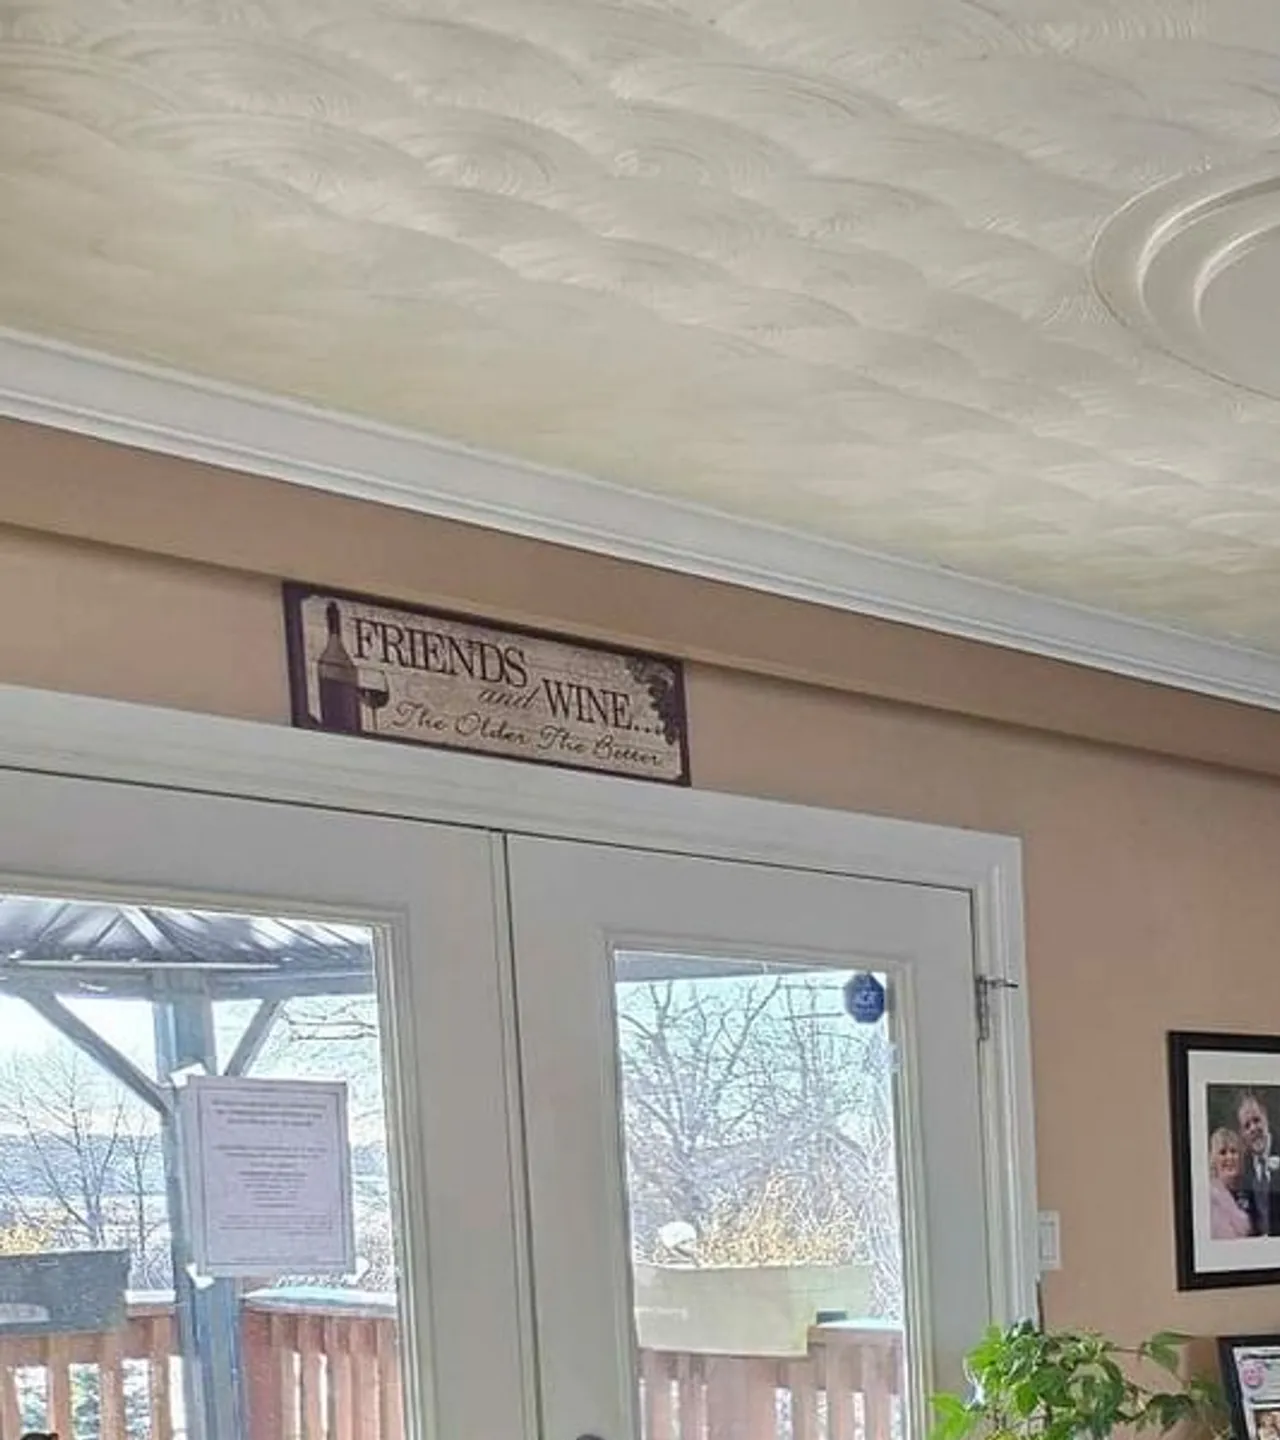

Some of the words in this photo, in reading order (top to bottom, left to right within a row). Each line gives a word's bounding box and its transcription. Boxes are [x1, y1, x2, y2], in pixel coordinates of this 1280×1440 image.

[353, 617, 528, 688] FRIENDS
[478, 685, 541, 709] and
[392, 701, 447, 731] The
[455, 712, 528, 743] Older
[537, 725, 586, 754] The
